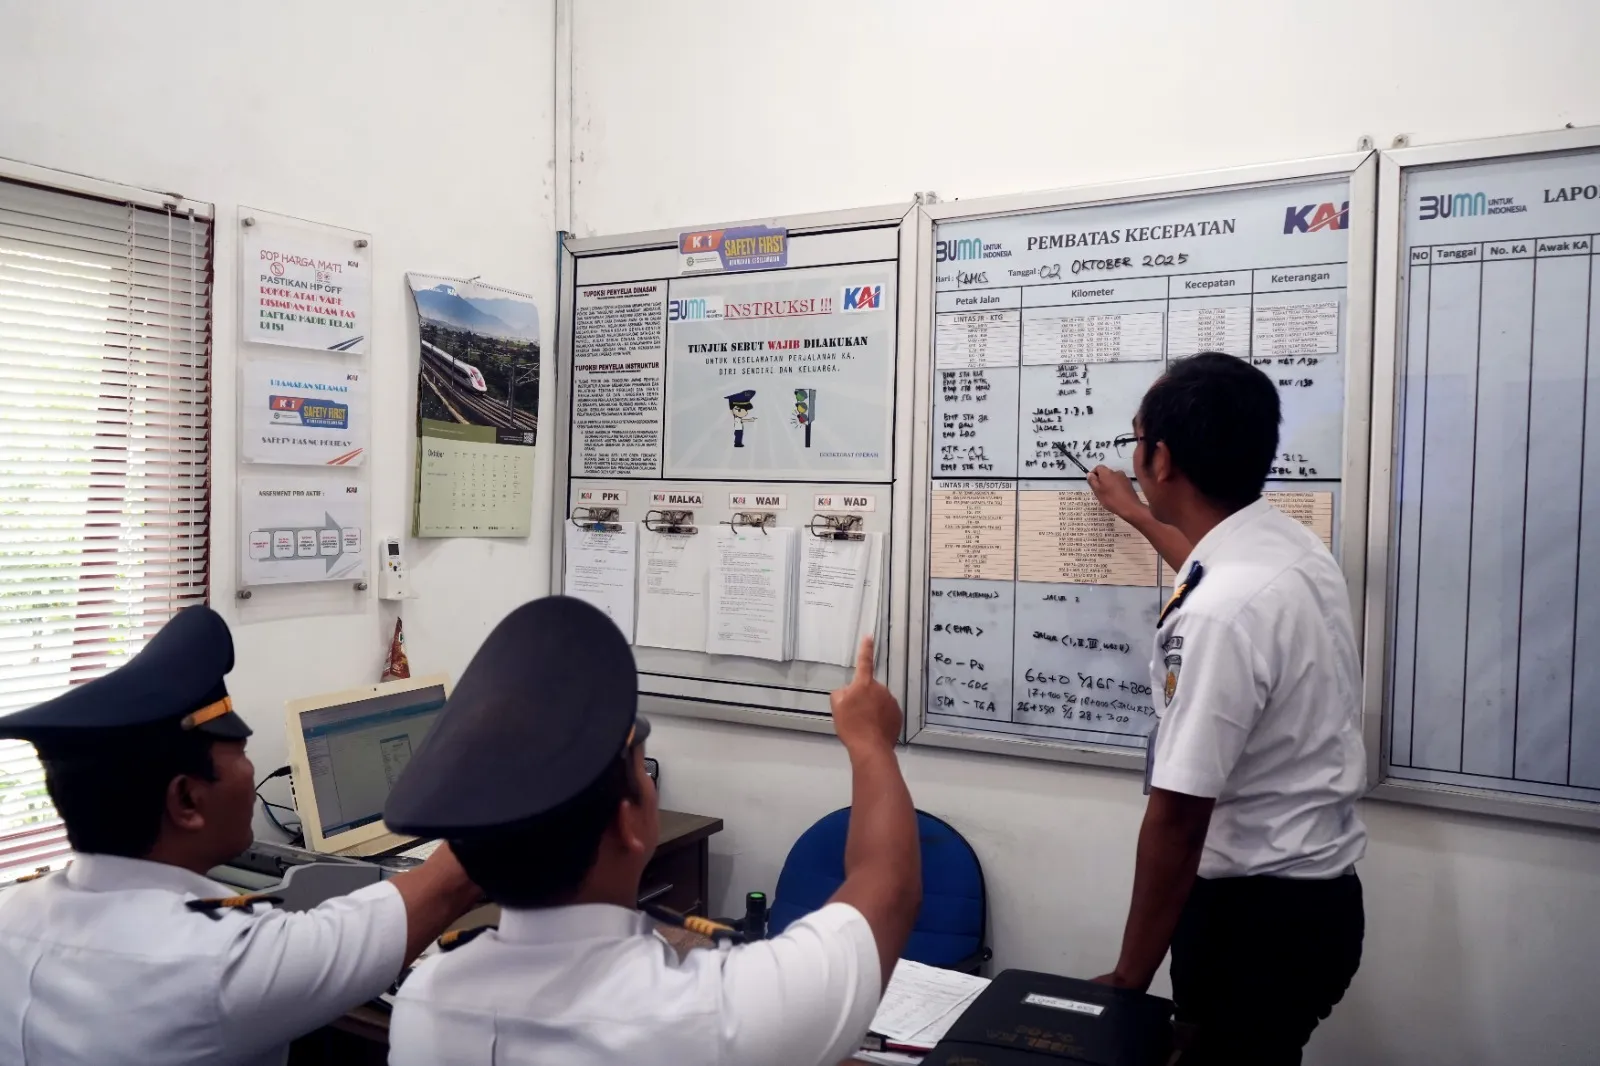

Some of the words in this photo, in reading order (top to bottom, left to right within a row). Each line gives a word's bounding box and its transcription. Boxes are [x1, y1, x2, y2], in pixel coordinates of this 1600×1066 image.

[1543, 185, 1600, 203] LAPO
[1488, 197, 1513, 206] UNTUK
[1488, 205, 1528, 215] INDONESIA
[1283, 200, 1349, 234] KAI
[1027, 229, 1120, 251] PEMBATAS
[1124, 218, 1236, 243] KECEPATAN
[724, 237, 756, 257] SAFETY
[758, 235, 784, 253] FIRST
[1490, 246, 1509, 256] No.
[1512, 244, 1528, 254] KA
[1539, 242, 1570, 253] Awak
[1572, 241, 1589, 250] KA
[983, 250, 1012, 259] INDONESIA
[1412, 252, 1429, 260] NO
[1437, 247, 1477, 259] Tanggal
[260, 249, 280, 262] SOP
[281, 253, 316, 269] HARGA
[318, 260, 343, 273] MATI
[1040, 263, 1062, 279] 02
[1071, 257, 1133, 274] OKTOBER
[1142, 253, 1189, 267] 2025
[260, 274, 308, 289] PASTIKAN
[309, 283, 323, 291] HP
[324, 285, 343, 294] OFF
[1185, 278, 1236, 290] Kecepatan
[1271, 272, 1330, 284] Keterangan
[844, 285, 881, 310] KAI
[1071, 288, 1115, 298] Kilometer
[955, 297, 978, 305] Petak
[979, 295, 1000, 304] Jalan
[340, 309, 356, 319] TAS
[724, 298, 815, 318] INSTRUKSI
[260, 309, 298, 321] DAFTAR
[688, 342, 728, 353] TUNJUK
[730, 341, 764, 351] SEBUT
[767, 340, 800, 350] WAJIB
[803, 336, 868, 349] DILAKUKAN
[705, 357, 728, 365] UNTUK
[732, 355, 784, 364] KESELAMATAN
[788, 353, 836, 362] PERJALANAN
[779, 366, 793, 374] DAN
[303, 406, 328, 419] SAFETY
[328, 408, 346, 420] FIRST
[669, 495, 701, 504] MALKA
[756, 497, 780, 505] WAM
[843, 497, 867, 506] WAD
